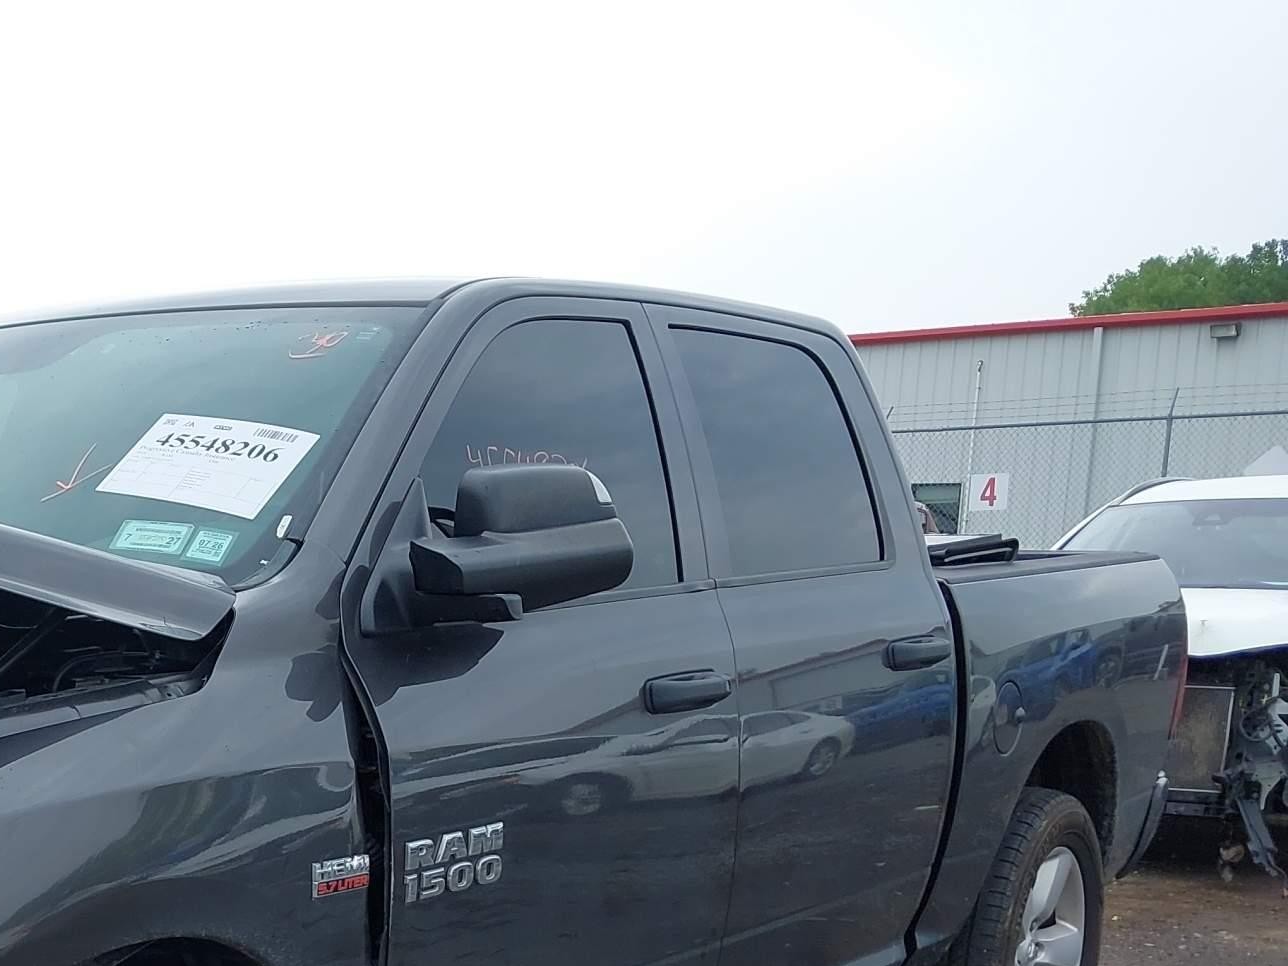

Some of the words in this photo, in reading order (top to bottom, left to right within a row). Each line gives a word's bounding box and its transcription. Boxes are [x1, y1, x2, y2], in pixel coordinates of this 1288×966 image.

[156, 432, 285, 463] 45548206
[980, 477, 997, 507] 4
[405, 821, 504, 870] RAM
[312, 854, 370, 882] HEMI
[404, 854, 503, 904] 1500
[317, 881, 337, 896] 5.7
[338, 873, 369, 890] LITER
